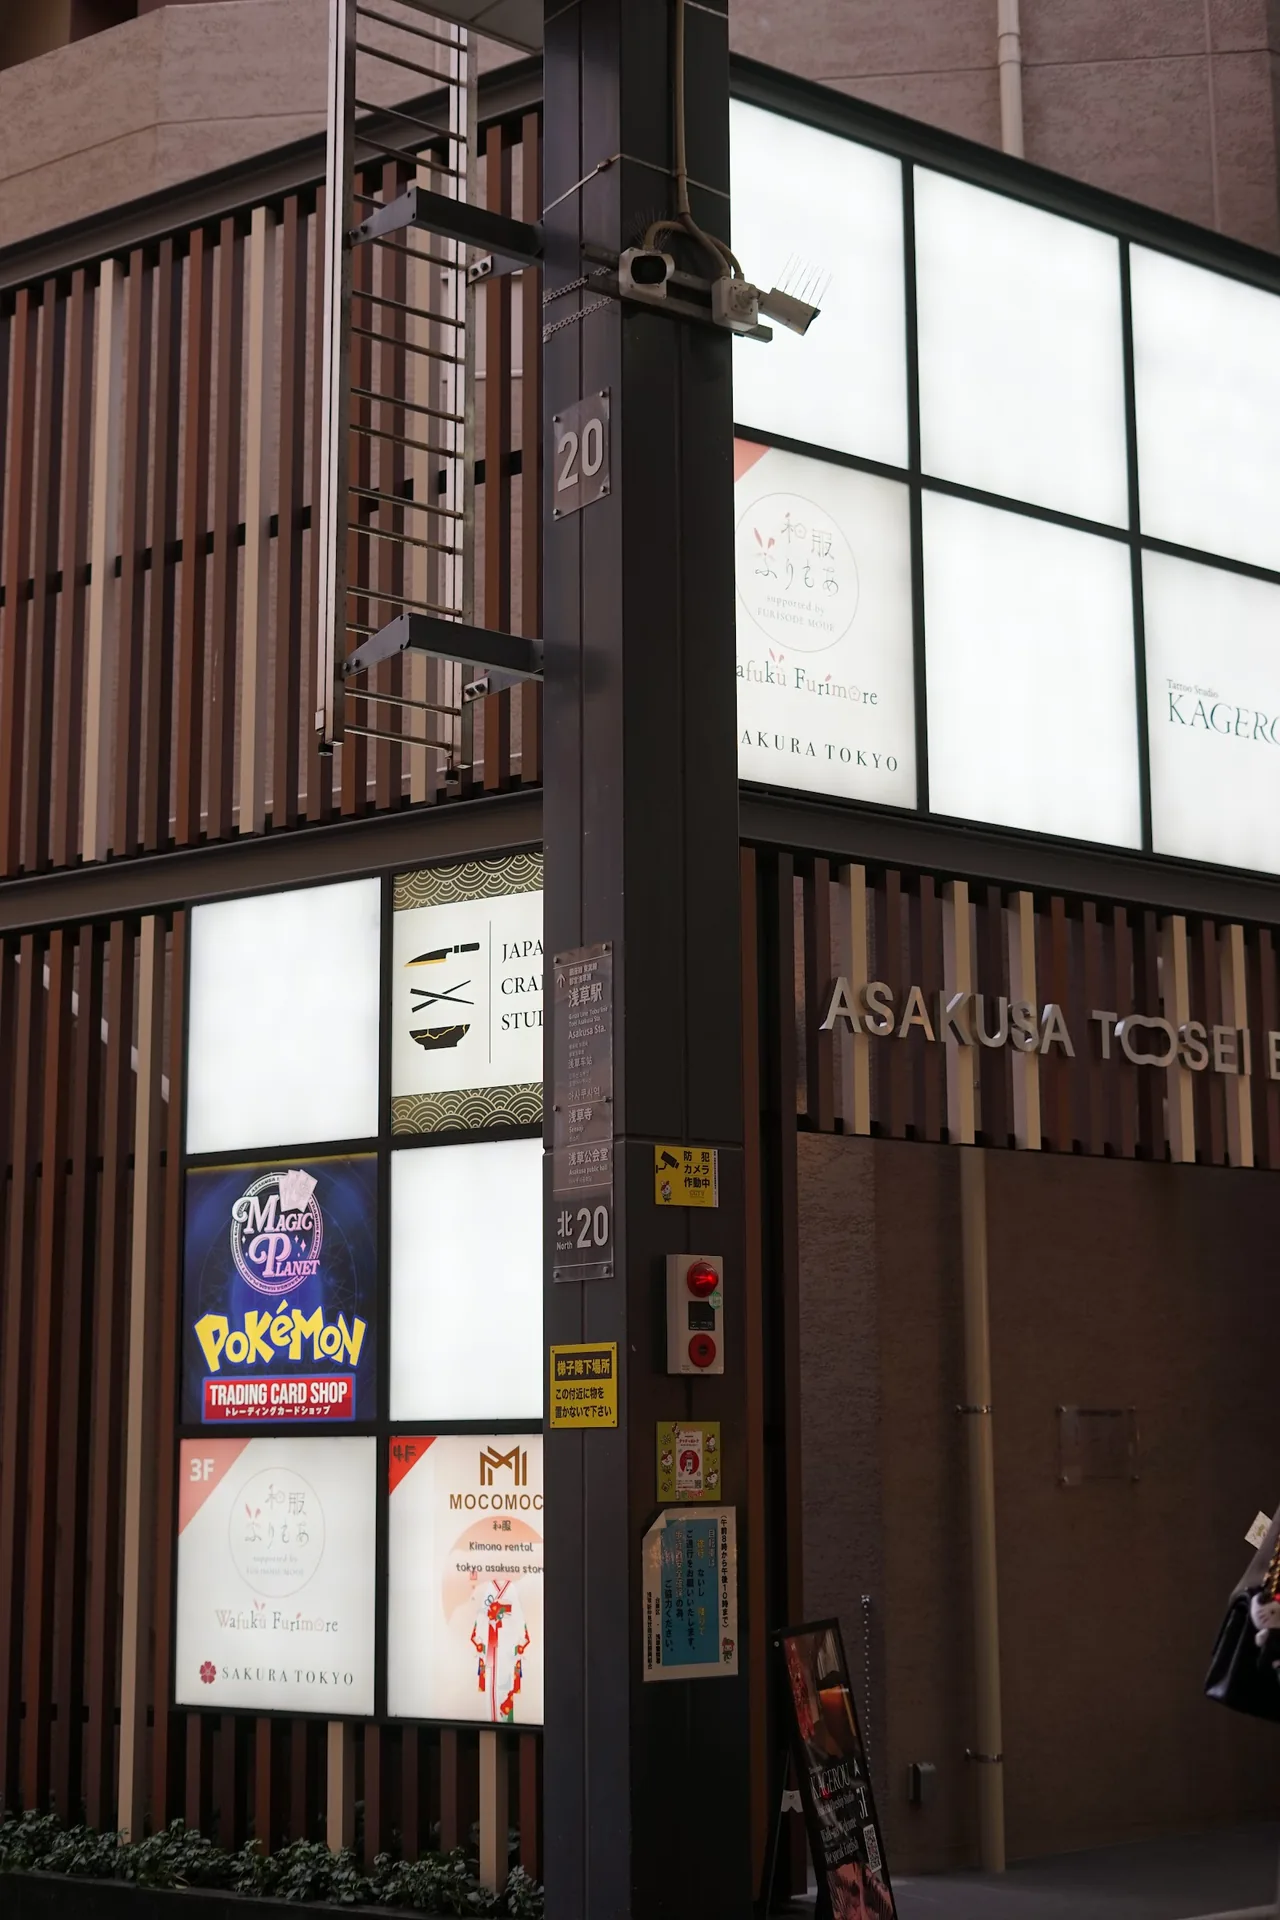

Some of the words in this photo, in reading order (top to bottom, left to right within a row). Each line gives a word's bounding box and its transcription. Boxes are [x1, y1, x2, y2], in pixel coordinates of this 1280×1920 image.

[557, 417, 603, 492] 20
[781, 513, 834, 559] 和服
[767, 594, 813, 613] supported
[815, 604, 825, 617] by
[757, 607, 804, 625] FURISODE
[808, 619, 834, 632] MODE
[794, 667, 878, 705] Furimore
[741, 730, 816, 757] AKURA
[825, 744, 897, 771] TOKYO
[501, 974, 543, 995] CRA
[568, 982, 602, 1007] 浅草駅
[501, 1009, 543, 1030] STU
[819, 976, 1075, 1058] ASAKUSA
[1092, 1009, 1250, 1076] TOSEI
[568, 1027, 594, 1040] Asakusa
[594, 1024, 606, 1034] Sta.
[568, 1086, 600, 1102] 아사쿠사역
[568, 1107, 592, 1123] 浅草寺
[568, 1148, 608, 1166] 浅草公会堂
[684, 1164, 710, 1174] カメラ
[684, 1177, 710, 1188] 作動中
[232, 1195, 313, 1234] MAGIC
[557, 1210, 573, 1237] 北
[577, 1205, 608, 1248] 20
[249, 1233, 320, 1277] PLANET
[557, 1241, 573, 1250] North
[210, 1384, 267, 1406] TRADING
[271, 1383, 307, 1404] CARD
[310, 1382, 348, 1403] SHOP
[556, 1387, 604, 1400] この付近に物を
[225, 1405, 331, 1416] トレーディングカードショップ
[555, 1405, 612, 1418] 置かないで下さい
[393, 1444, 416, 1463] 4F
[189, 1459, 215, 1481] 3F
[265, 1484, 307, 1516] 和服
[493, 1520, 512, 1532] 和服
[469, 1541, 502, 1552] Kimono
[505, 1541, 534, 1553] rental
[456, 1562, 483, 1578] tokyo
[485, 1562, 520, 1574] asakusa
[697, 1569, 705, 1597] ないし
[215, 1609, 267, 1630] Wafuku
[273, 1611, 338, 1632] Furimore
[222, 1667, 288, 1683] SAKURA
[295, 1670, 353, 1686] TOKYO
[810, 1763, 850, 1799] KAGEROU
